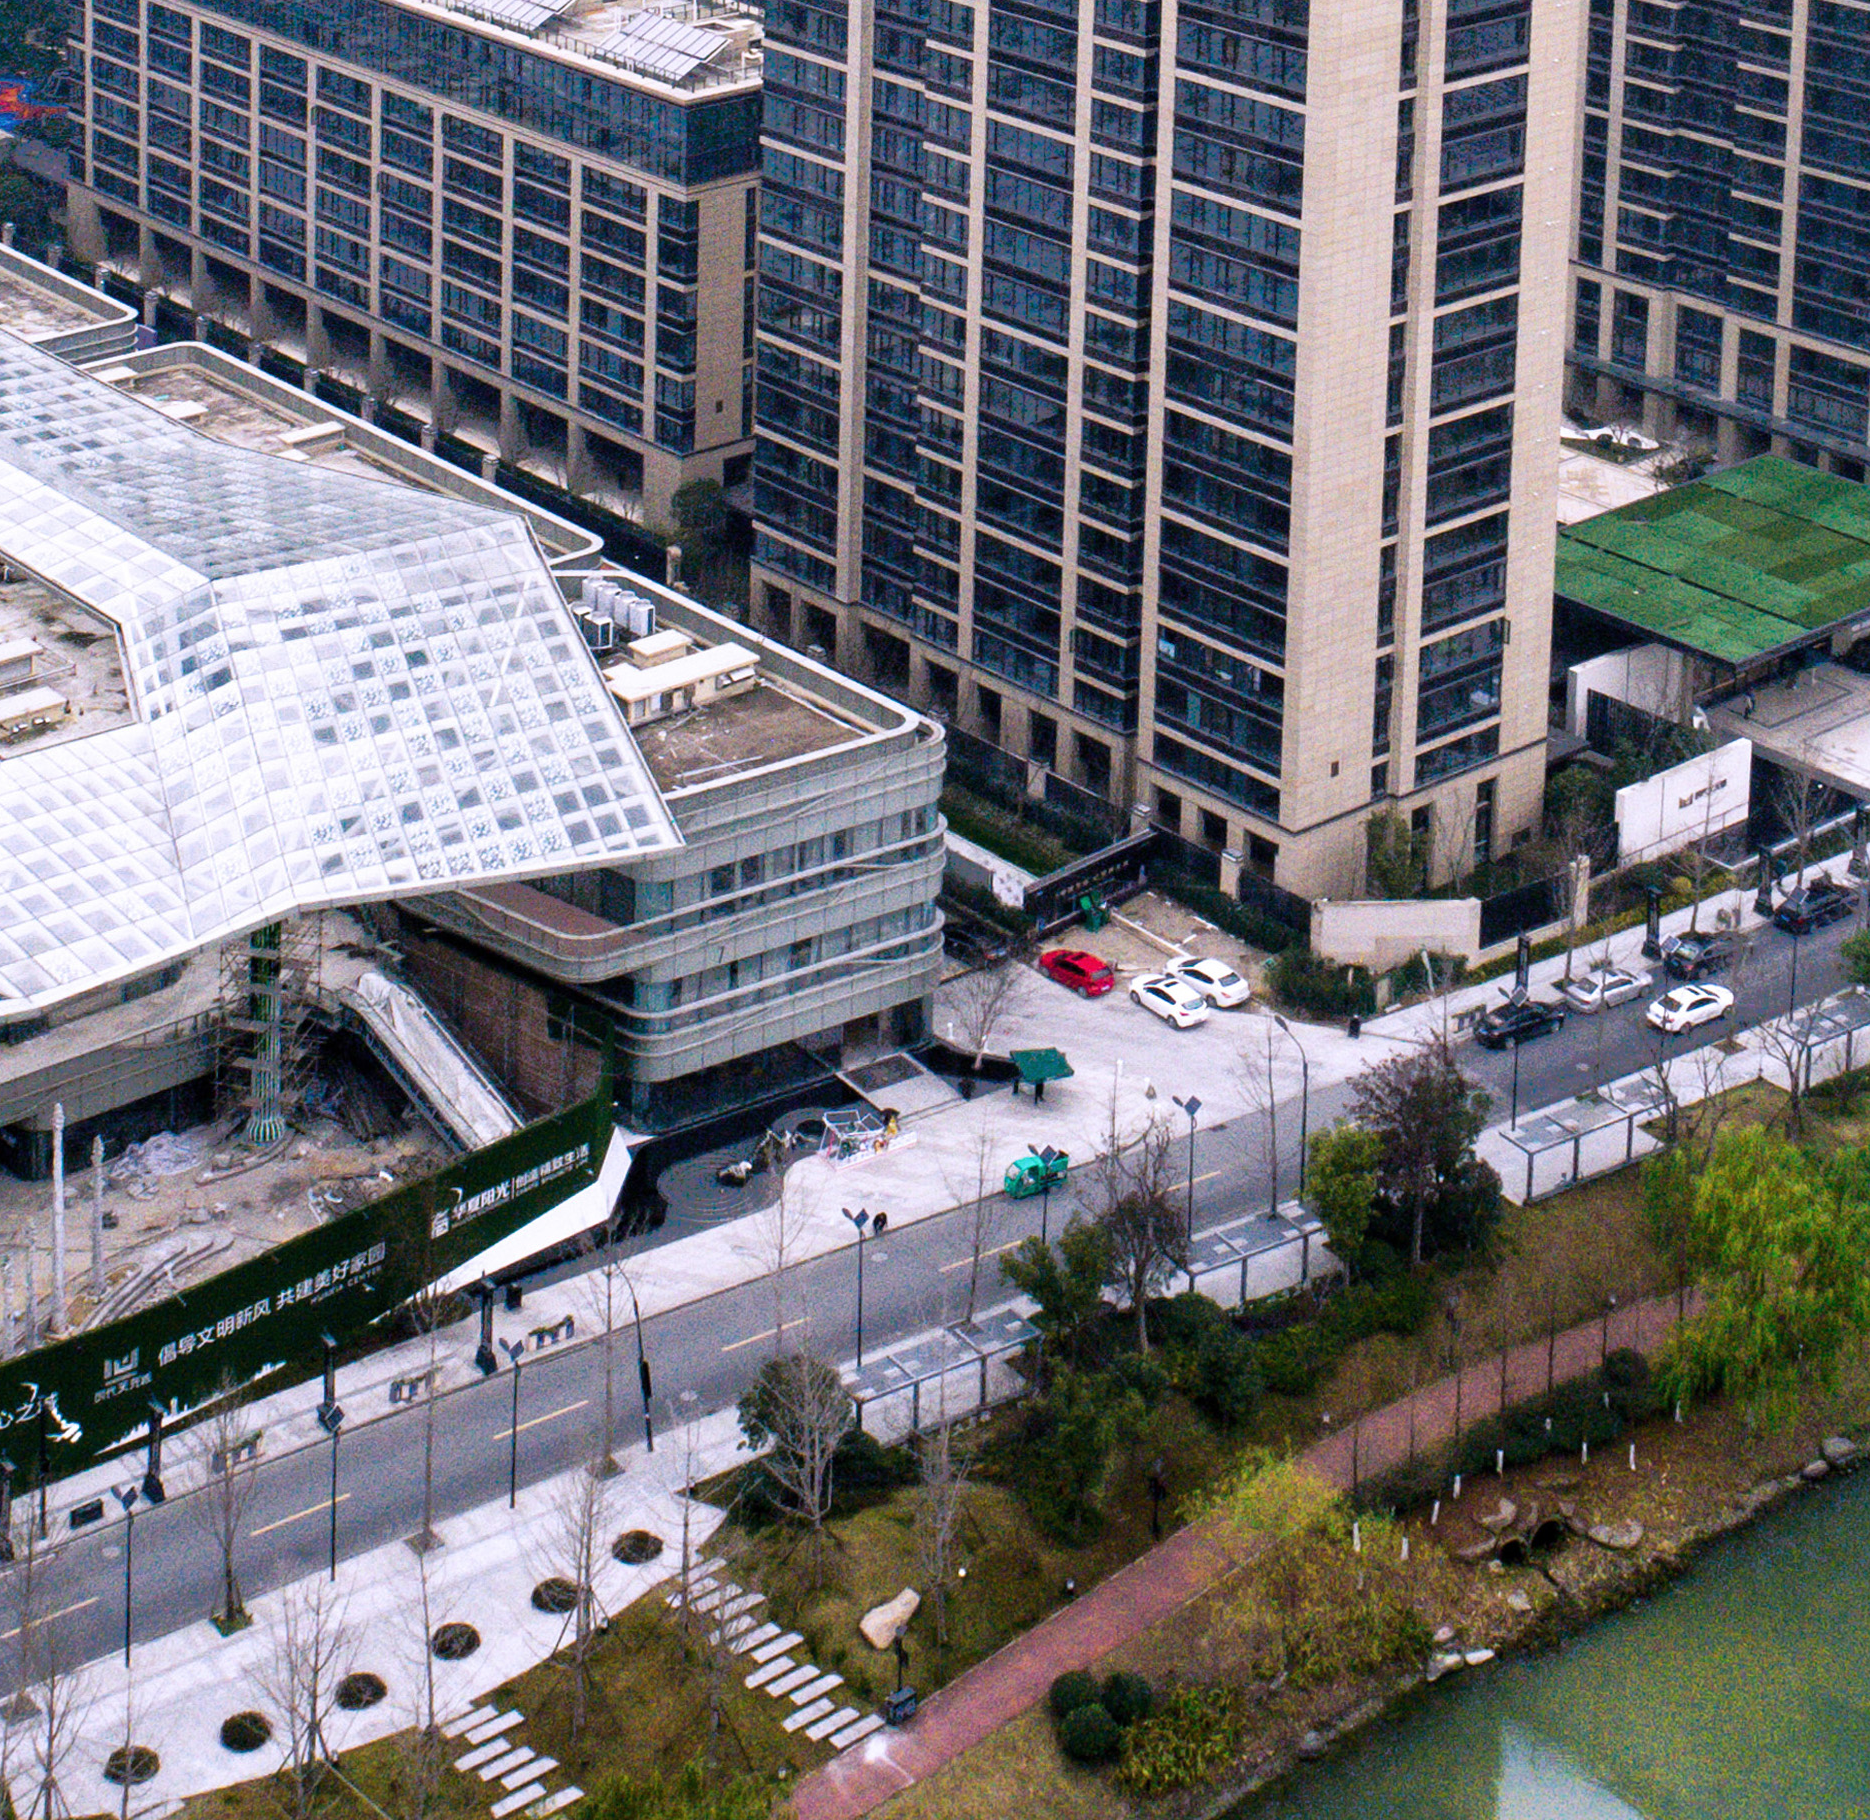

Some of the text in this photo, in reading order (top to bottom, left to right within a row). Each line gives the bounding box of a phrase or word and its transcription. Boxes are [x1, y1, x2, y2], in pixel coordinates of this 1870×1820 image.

[158, 1241, 386, 1367] 倡导文明新风 共建美好家园
